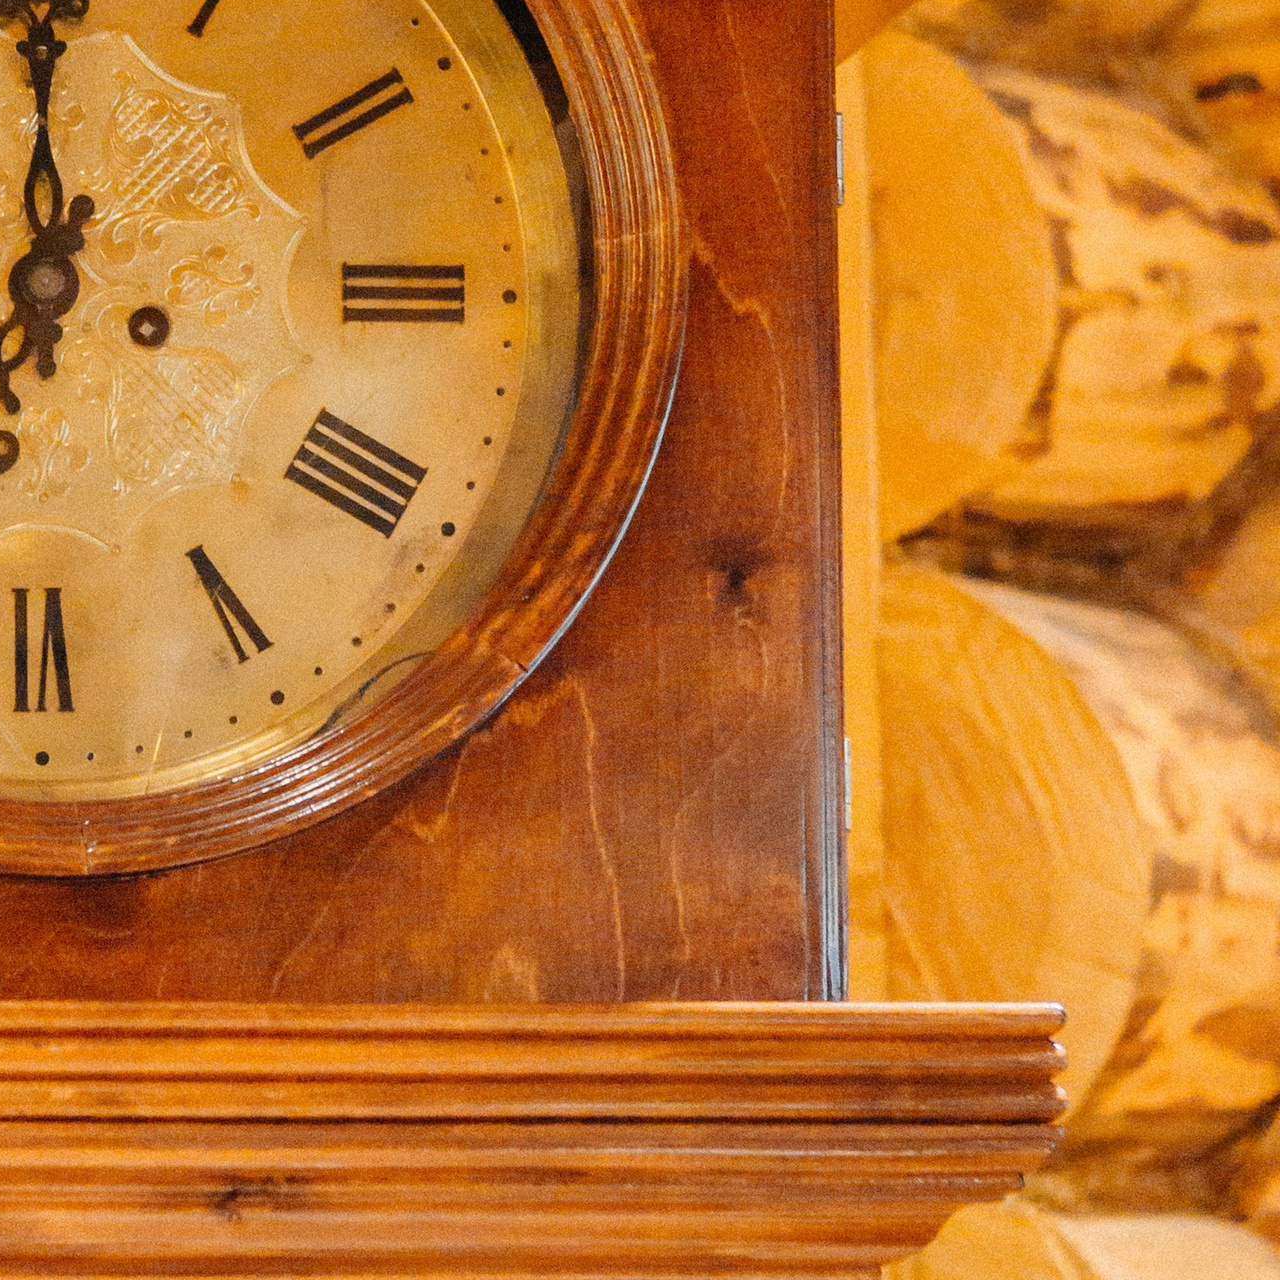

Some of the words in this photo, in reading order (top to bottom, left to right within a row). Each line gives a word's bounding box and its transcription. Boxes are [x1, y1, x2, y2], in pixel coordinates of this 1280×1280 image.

[291, 67, 415, 160] II
[341, 262, 466, 324] III
[284, 408, 428, 539] IIII
[11, 587, 75, 713] VI
[185, 544, 274, 665] V
